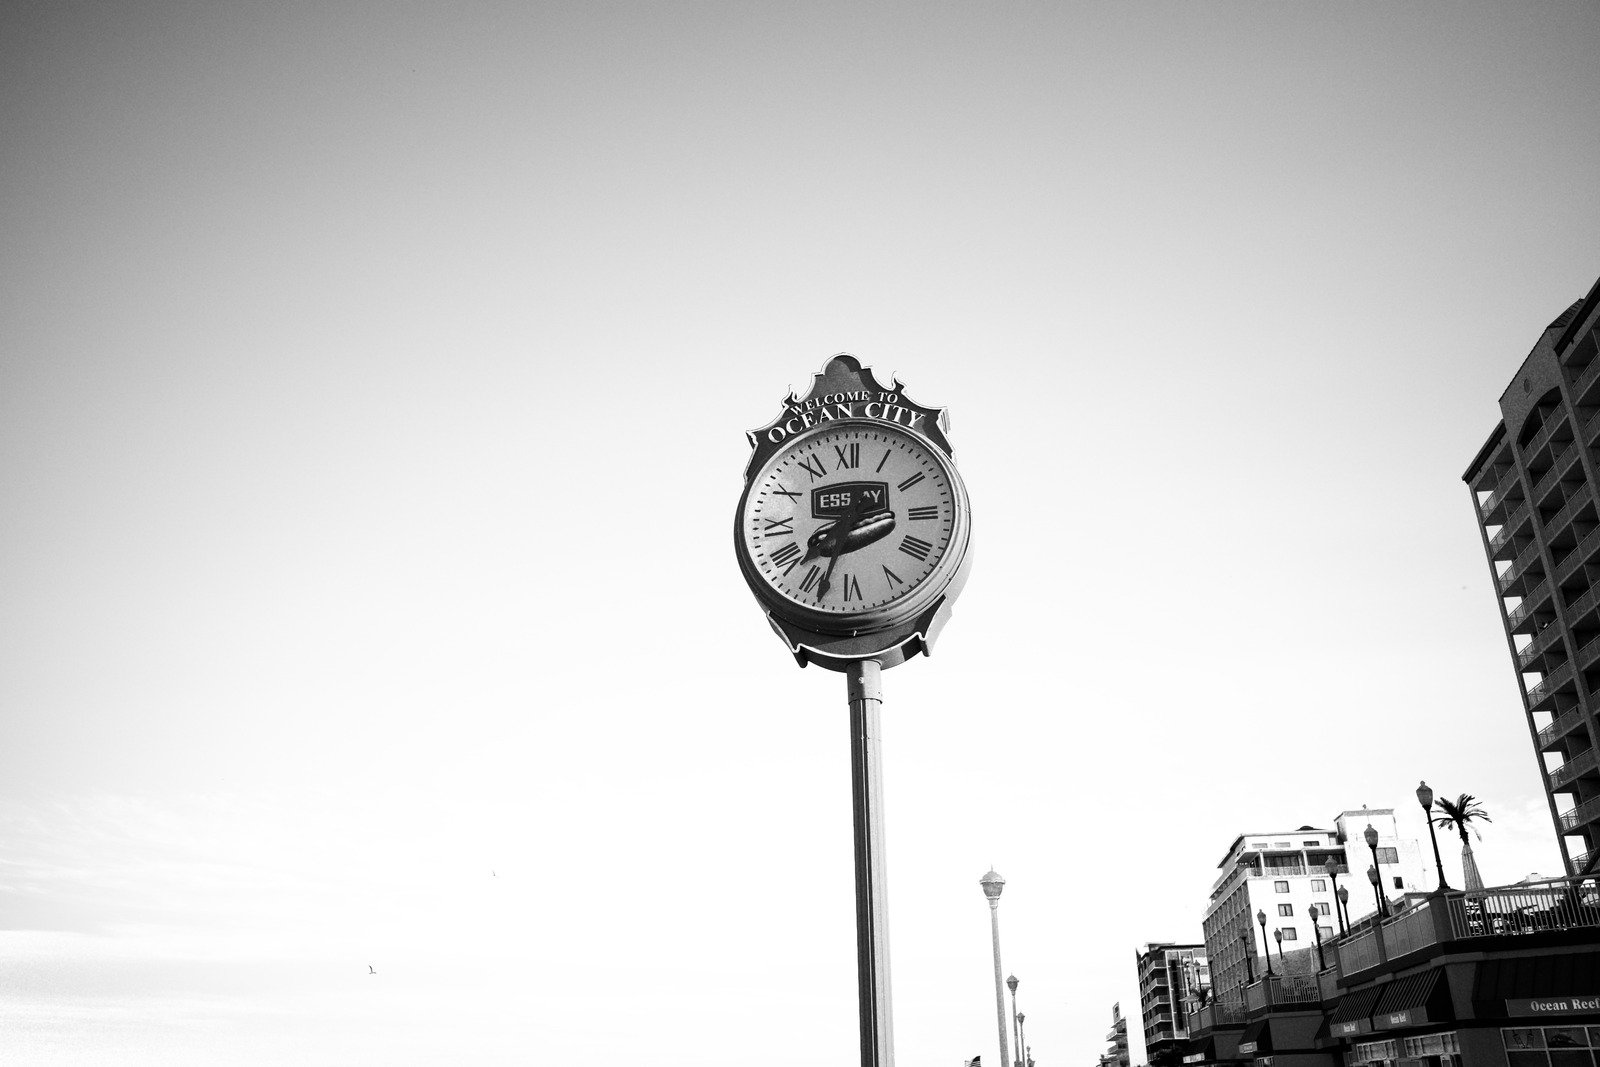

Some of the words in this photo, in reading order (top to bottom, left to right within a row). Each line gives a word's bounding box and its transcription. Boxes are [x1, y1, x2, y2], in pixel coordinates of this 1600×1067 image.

[790, 390, 870, 416] WELCOME
[878, 391, 898, 404] TO
[767, 402, 853, 443] OCEAN
[864, 402, 926, 428] CITY
[798, 453, 827, 483] XI
[834, 443, 859, 470] XII
[897, 471, 926, 492] II
[773, 483, 802, 504] X
[820, 489, 881, 508] ESSY
[908, 505, 939, 521] III
[764, 517, 793, 537] IX
[844, 573, 863, 602] VI
[882, 564, 904, 590] V
[1530, 1001, 1568, 1011] Ocean
[1571, 998, 1600, 1009] Reef
